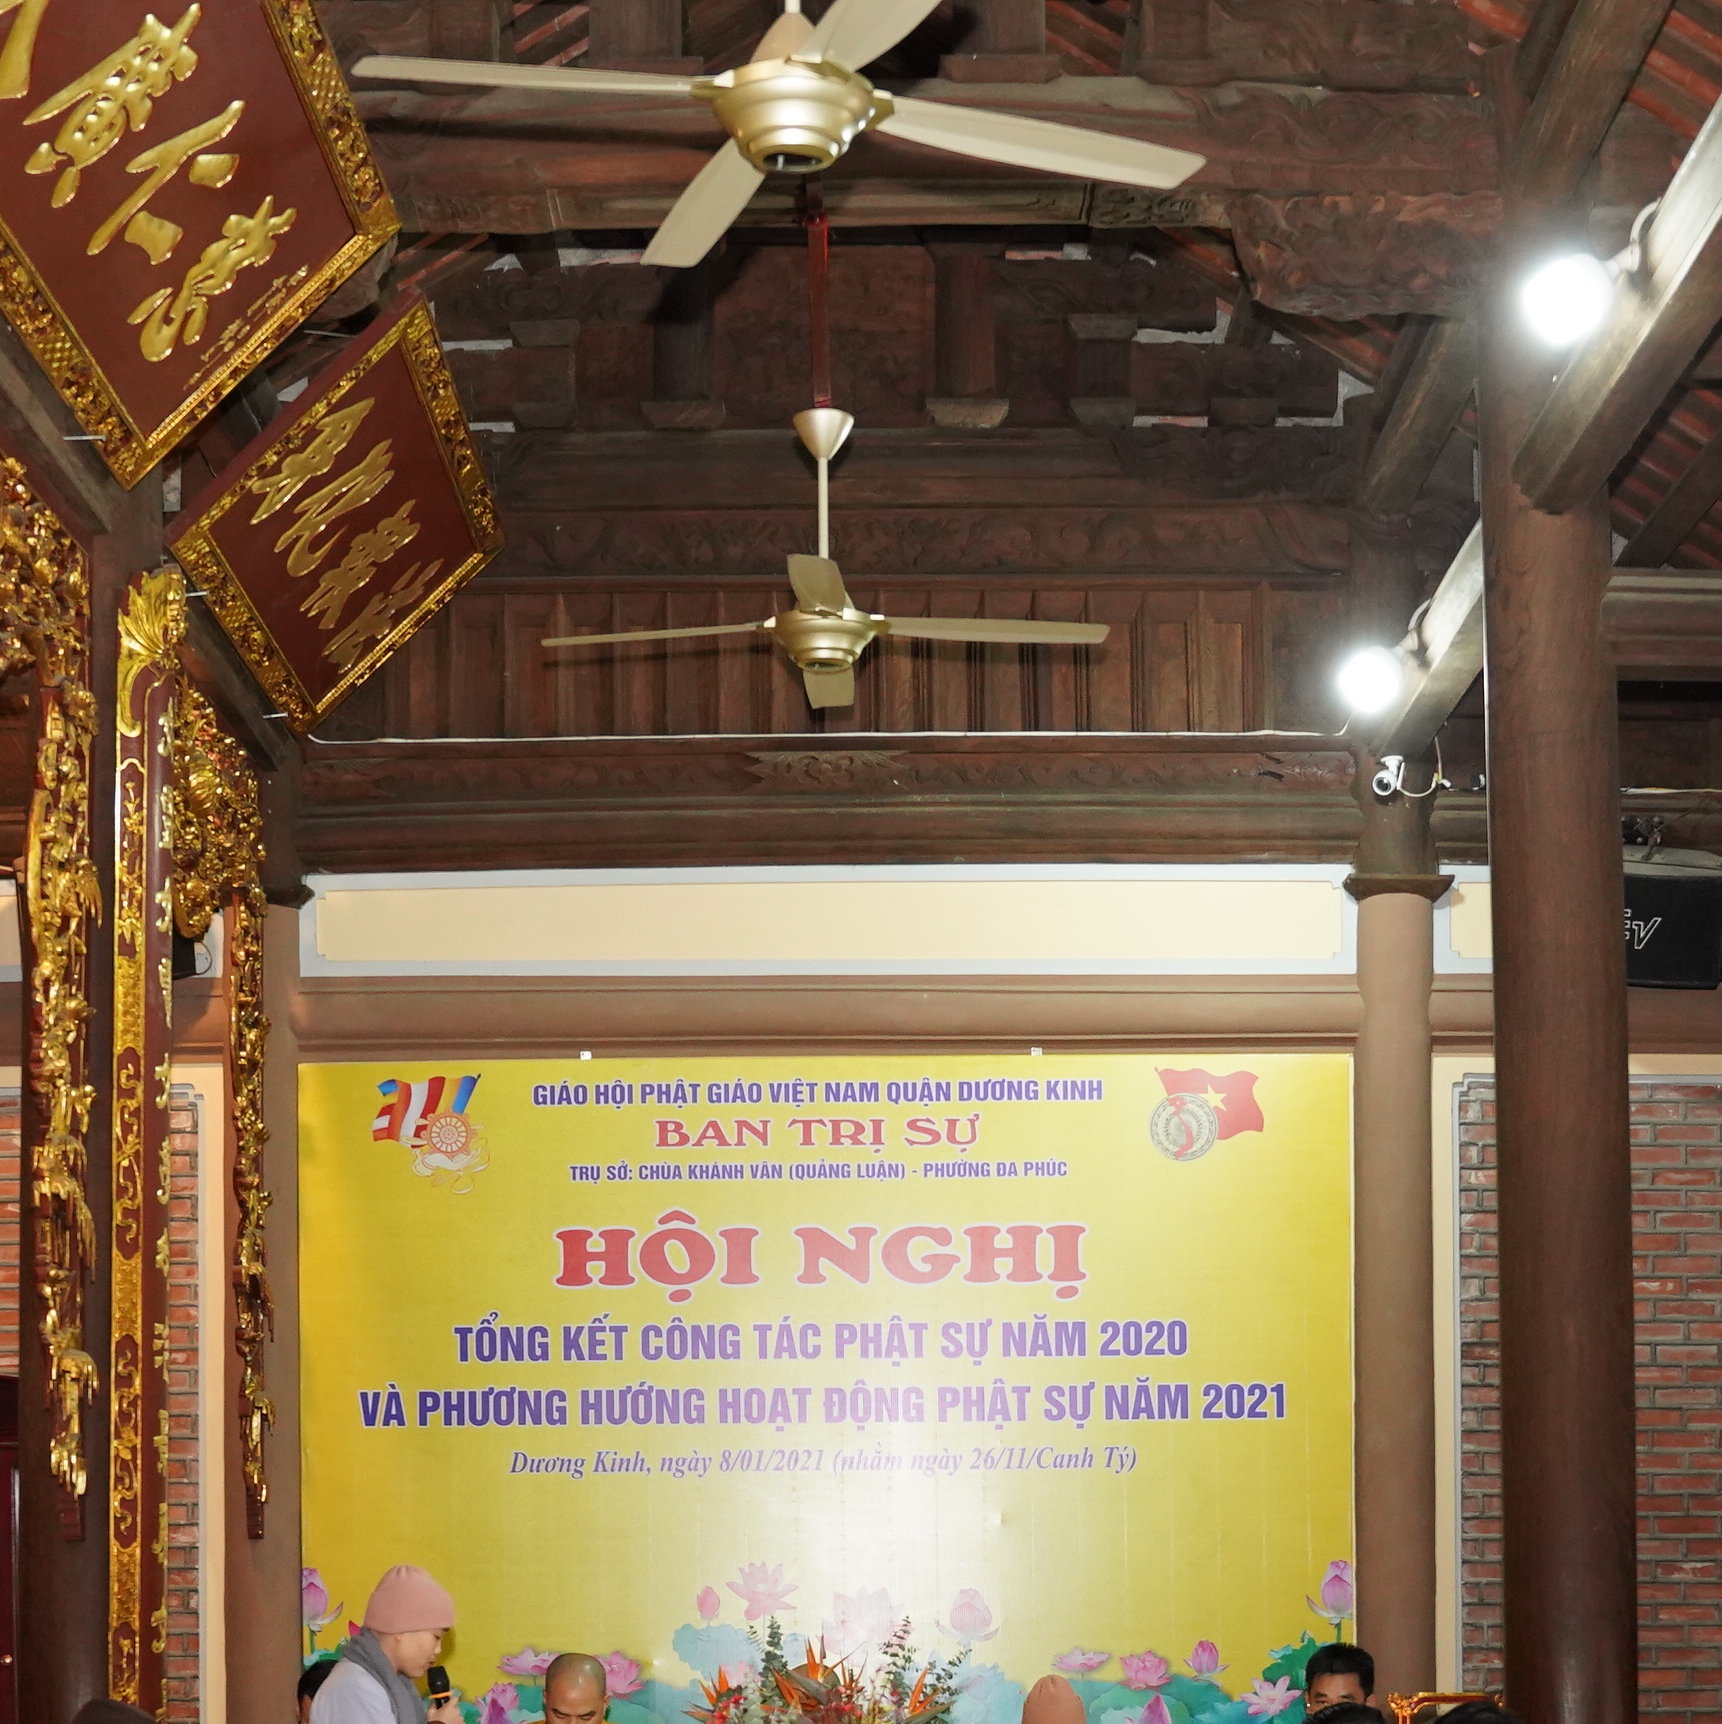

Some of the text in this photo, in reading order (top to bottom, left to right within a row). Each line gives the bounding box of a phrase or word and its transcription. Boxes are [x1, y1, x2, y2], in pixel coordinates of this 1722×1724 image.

[533, 1078, 1102, 1109] GIÁO HỘI PHẬT GIÁO VIỆT NAM QUẬN DƯƠNG KINH
[655, 1113, 980, 1153] BAN TRỊ SỰ
[570, 1165, 600, 1184] TRỤ
[607, 1160, 632, 1181] SỞ:
[639, 1162, 682, 1180] CHÙA
[688, 1161, 744, 1180] KHÁNH
[750, 1161, 783, 1179] VÂN
[789, 1158, 851, 1180] (QUẢNG
[857, 1160, 905, 1182] LUẬN)
[923, 1159, 990, 1178] PHƯỜNG
[996, 1162, 1018, 1177] ĐA
[1024, 1158, 1068, 1177] PHÚC
[555, 1209, 1087, 1303] HỘI NGHỊ
[454, 1312, 1188, 1367] TỔNG KẾT CÔNG TÁC PHẬT SỰ NĂM 2020
[359, 1377, 1285, 1431] VÀ PHƯƠNG HƯỚNG HOẠT ĐỘNG PHẬT SỰ NĂM 2021
[510, 1442, 1137, 1479] Dương Kinh, ngày 8/01/2021 (nhằm ngày 26/11/Canh Tý)
